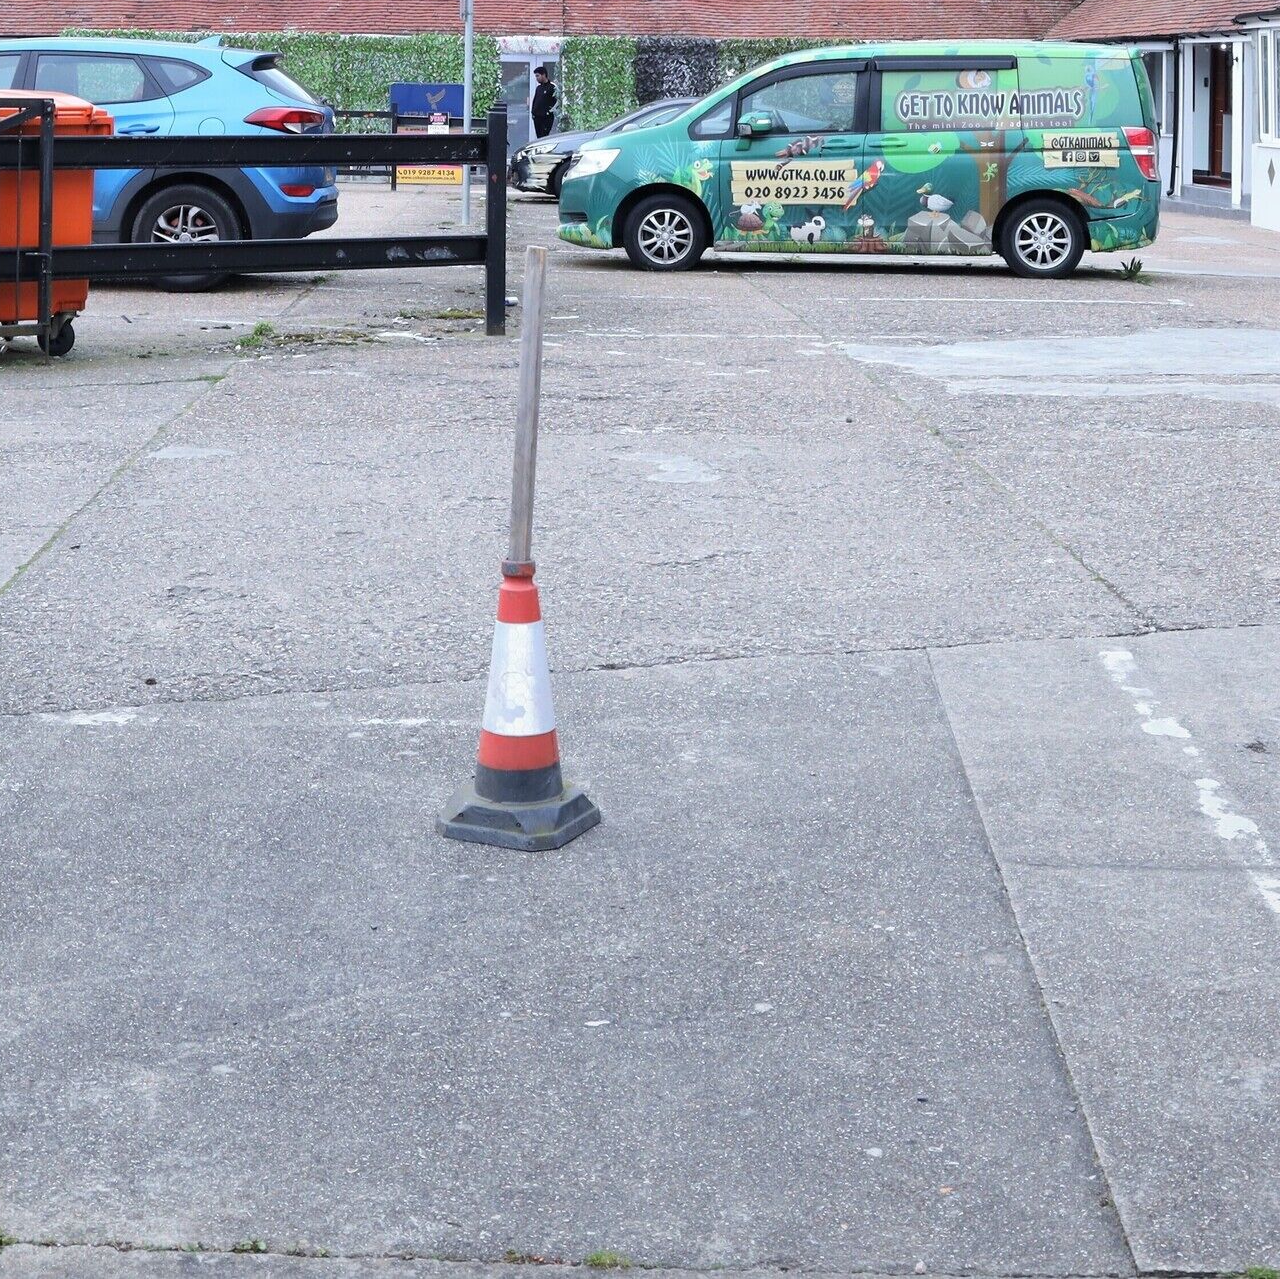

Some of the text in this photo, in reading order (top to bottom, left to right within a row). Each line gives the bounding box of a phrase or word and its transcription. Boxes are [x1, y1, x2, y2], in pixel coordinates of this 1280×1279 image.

[899, 89, 1083, 119] GET TO KNOW ANIMALS
[1051, 136, 1113, 149] @GTKANIMALS
[746, 168, 846, 181] WWW.GTKA.CO.UK
[744, 186, 845, 199] 020 8923 3456
